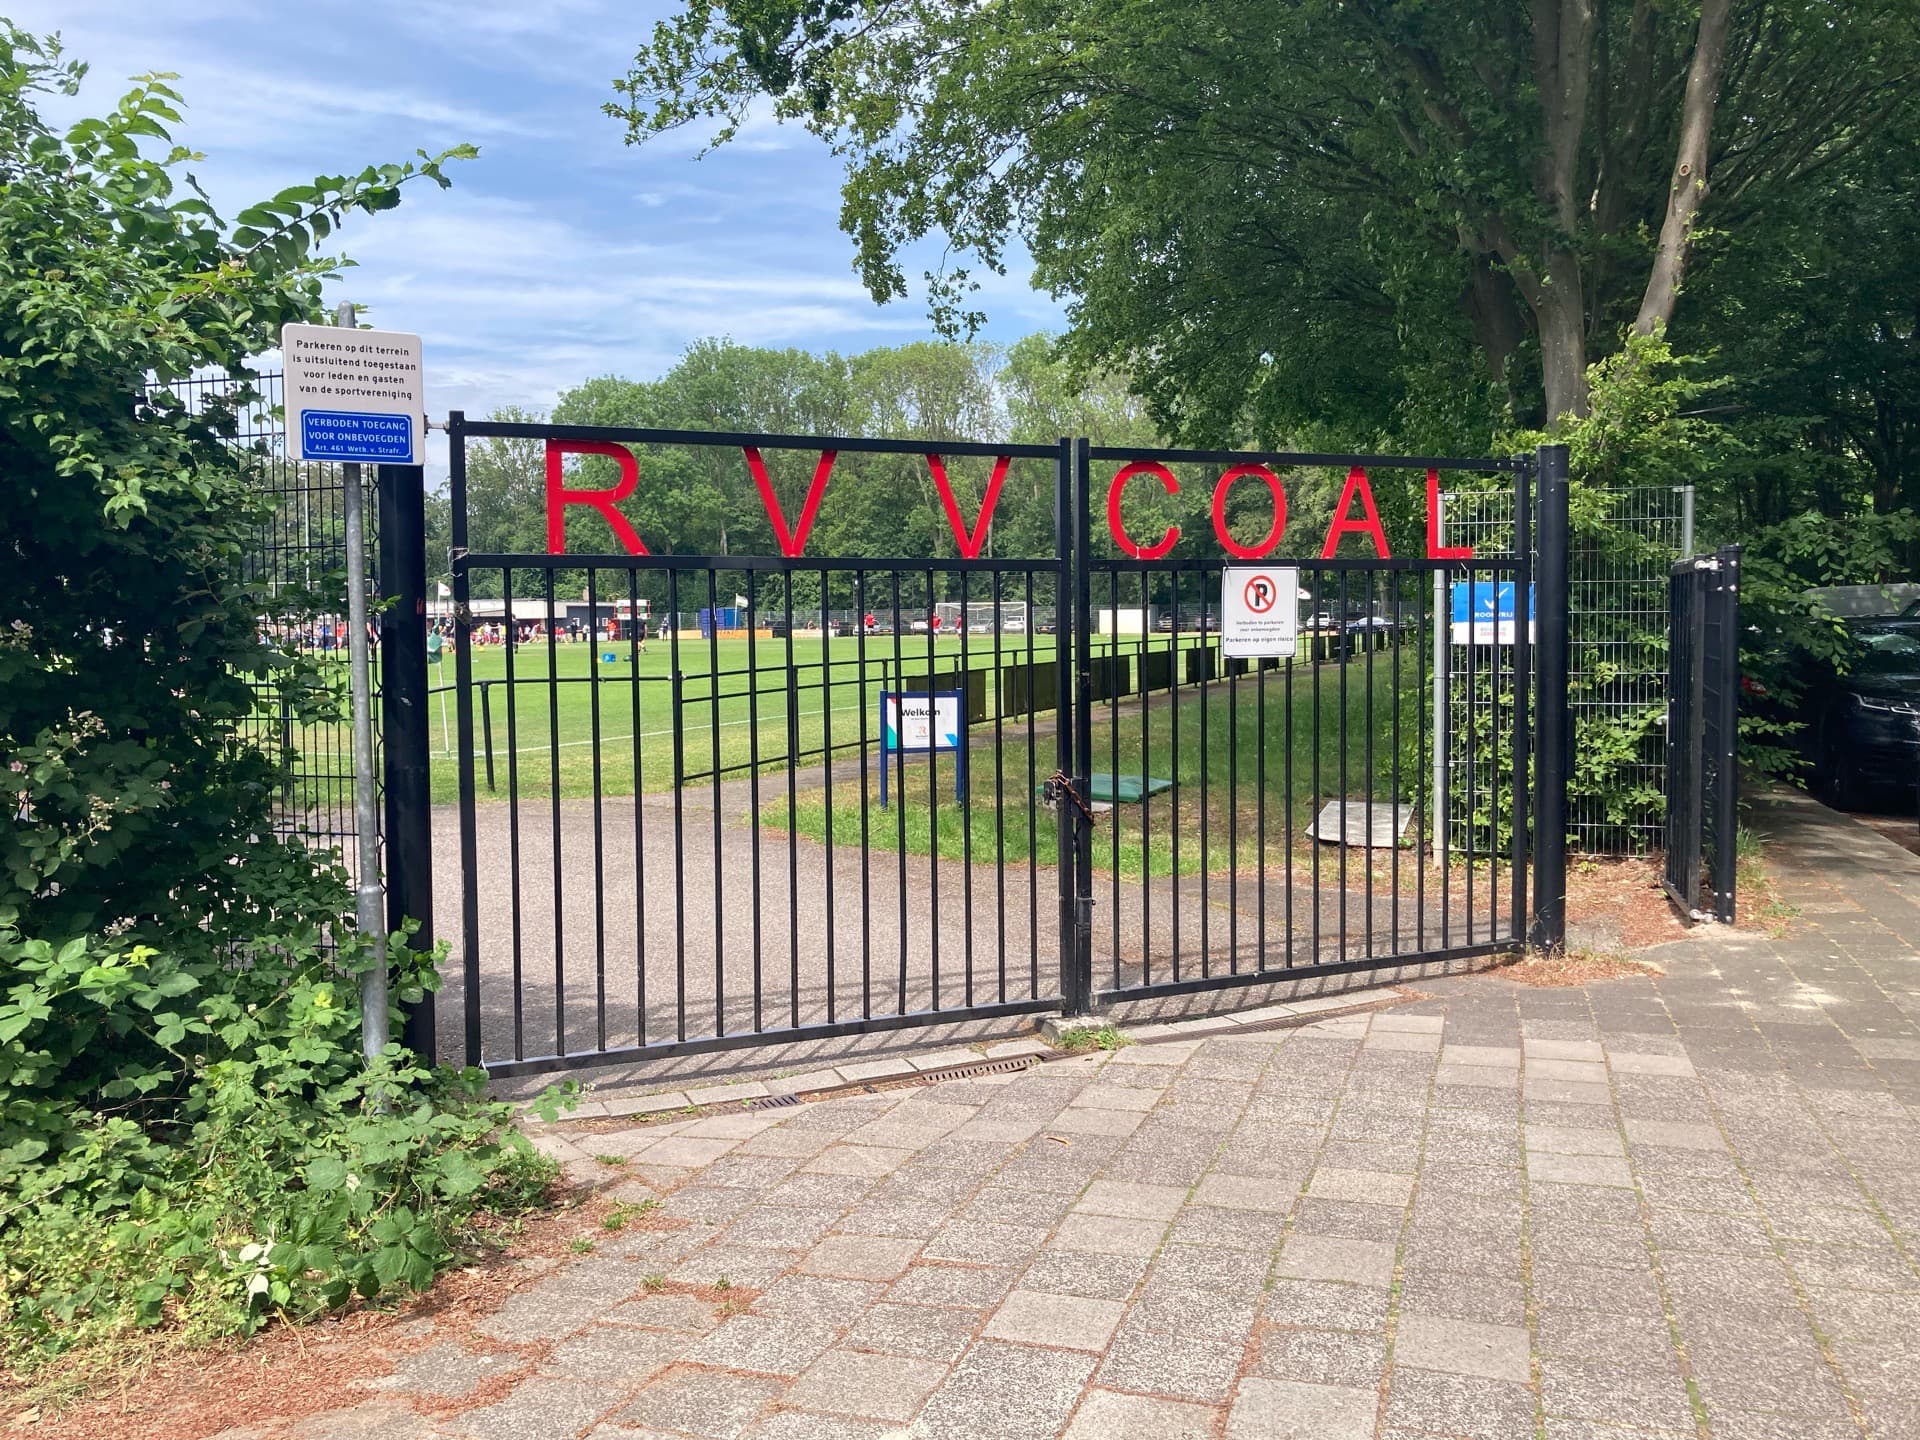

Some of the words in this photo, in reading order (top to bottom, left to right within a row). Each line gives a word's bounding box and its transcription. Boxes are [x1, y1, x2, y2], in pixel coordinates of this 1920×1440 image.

[297, 340, 342, 351] Parkeren
[345, 345, 356, 353] op
[360, 345, 373, 354] dit
[376, 347, 409, 356] terrein
[293, 355, 301, 363] is
[305, 355, 360, 367] uitsluitend
[364, 360, 416, 371] toegestaan
[304, 371, 325, 379] voor
[328, 372, 354, 381] leden
[358, 374, 369, 382] en
[373, 375, 404, 385] gasten
[299, 385, 317, 393] van
[321, 385, 332, 394] de
[335, 387, 413, 400] sportvereniging
[308, 418, 359, 428] VERBODEN
[362, 420, 406, 431] TOEGANG
[309, 431, 335, 440] VOOR
[338, 433, 406, 443] ONBEVOEGDEN
[314, 444, 329, 452] Art.
[378, 447, 401, 455] Strafr.
[1107, 463, 1473, 562] COAL
